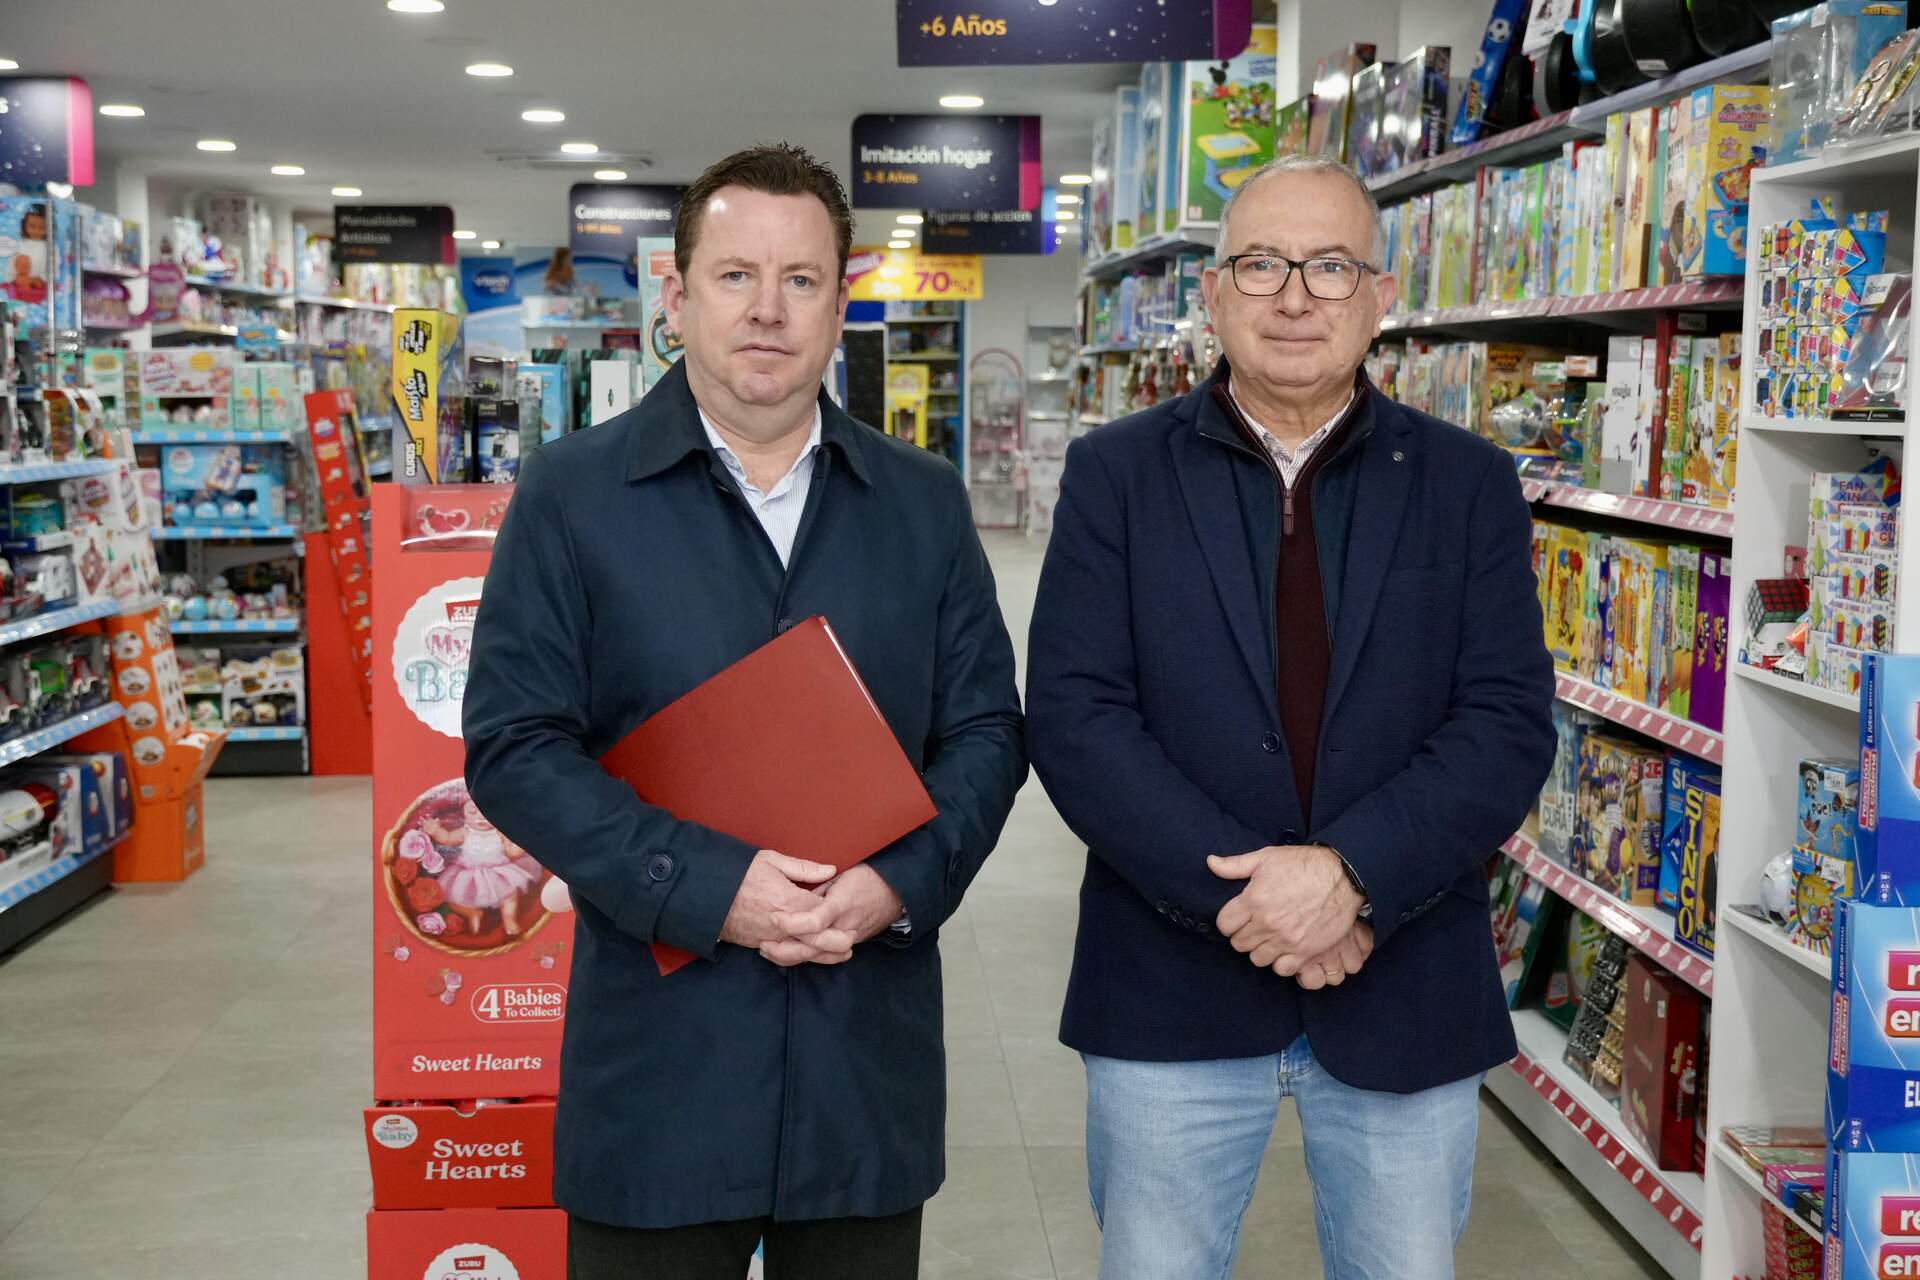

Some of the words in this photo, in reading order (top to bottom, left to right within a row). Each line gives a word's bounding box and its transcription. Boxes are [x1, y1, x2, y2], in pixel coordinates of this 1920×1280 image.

[920, 17, 946, 37] +6
[952, 15, 1007, 36] Años
[861, 144, 941, 164] Imitación
[943, 145, 993, 169] hogar
[403, 376, 422, 422] Maisto
[1839, 480, 1864, 490] FAN
[1866, 708, 1874, 733] JUEGO
[1542, 804, 1568, 831] CURA
[1678, 787, 1703, 939] SINCO
[478, 989, 500, 1019] 4
[504, 988, 561, 1006] Babies
[505, 1006, 519, 1017] To
[520, 1005, 561, 1018] Collect!
[411, 1055, 469, 1073] Sweet
[474, 1053, 542, 1071] Hearts
[432, 1138, 523, 1158] Sweet
[424, 1161, 526, 1181] Hearts
